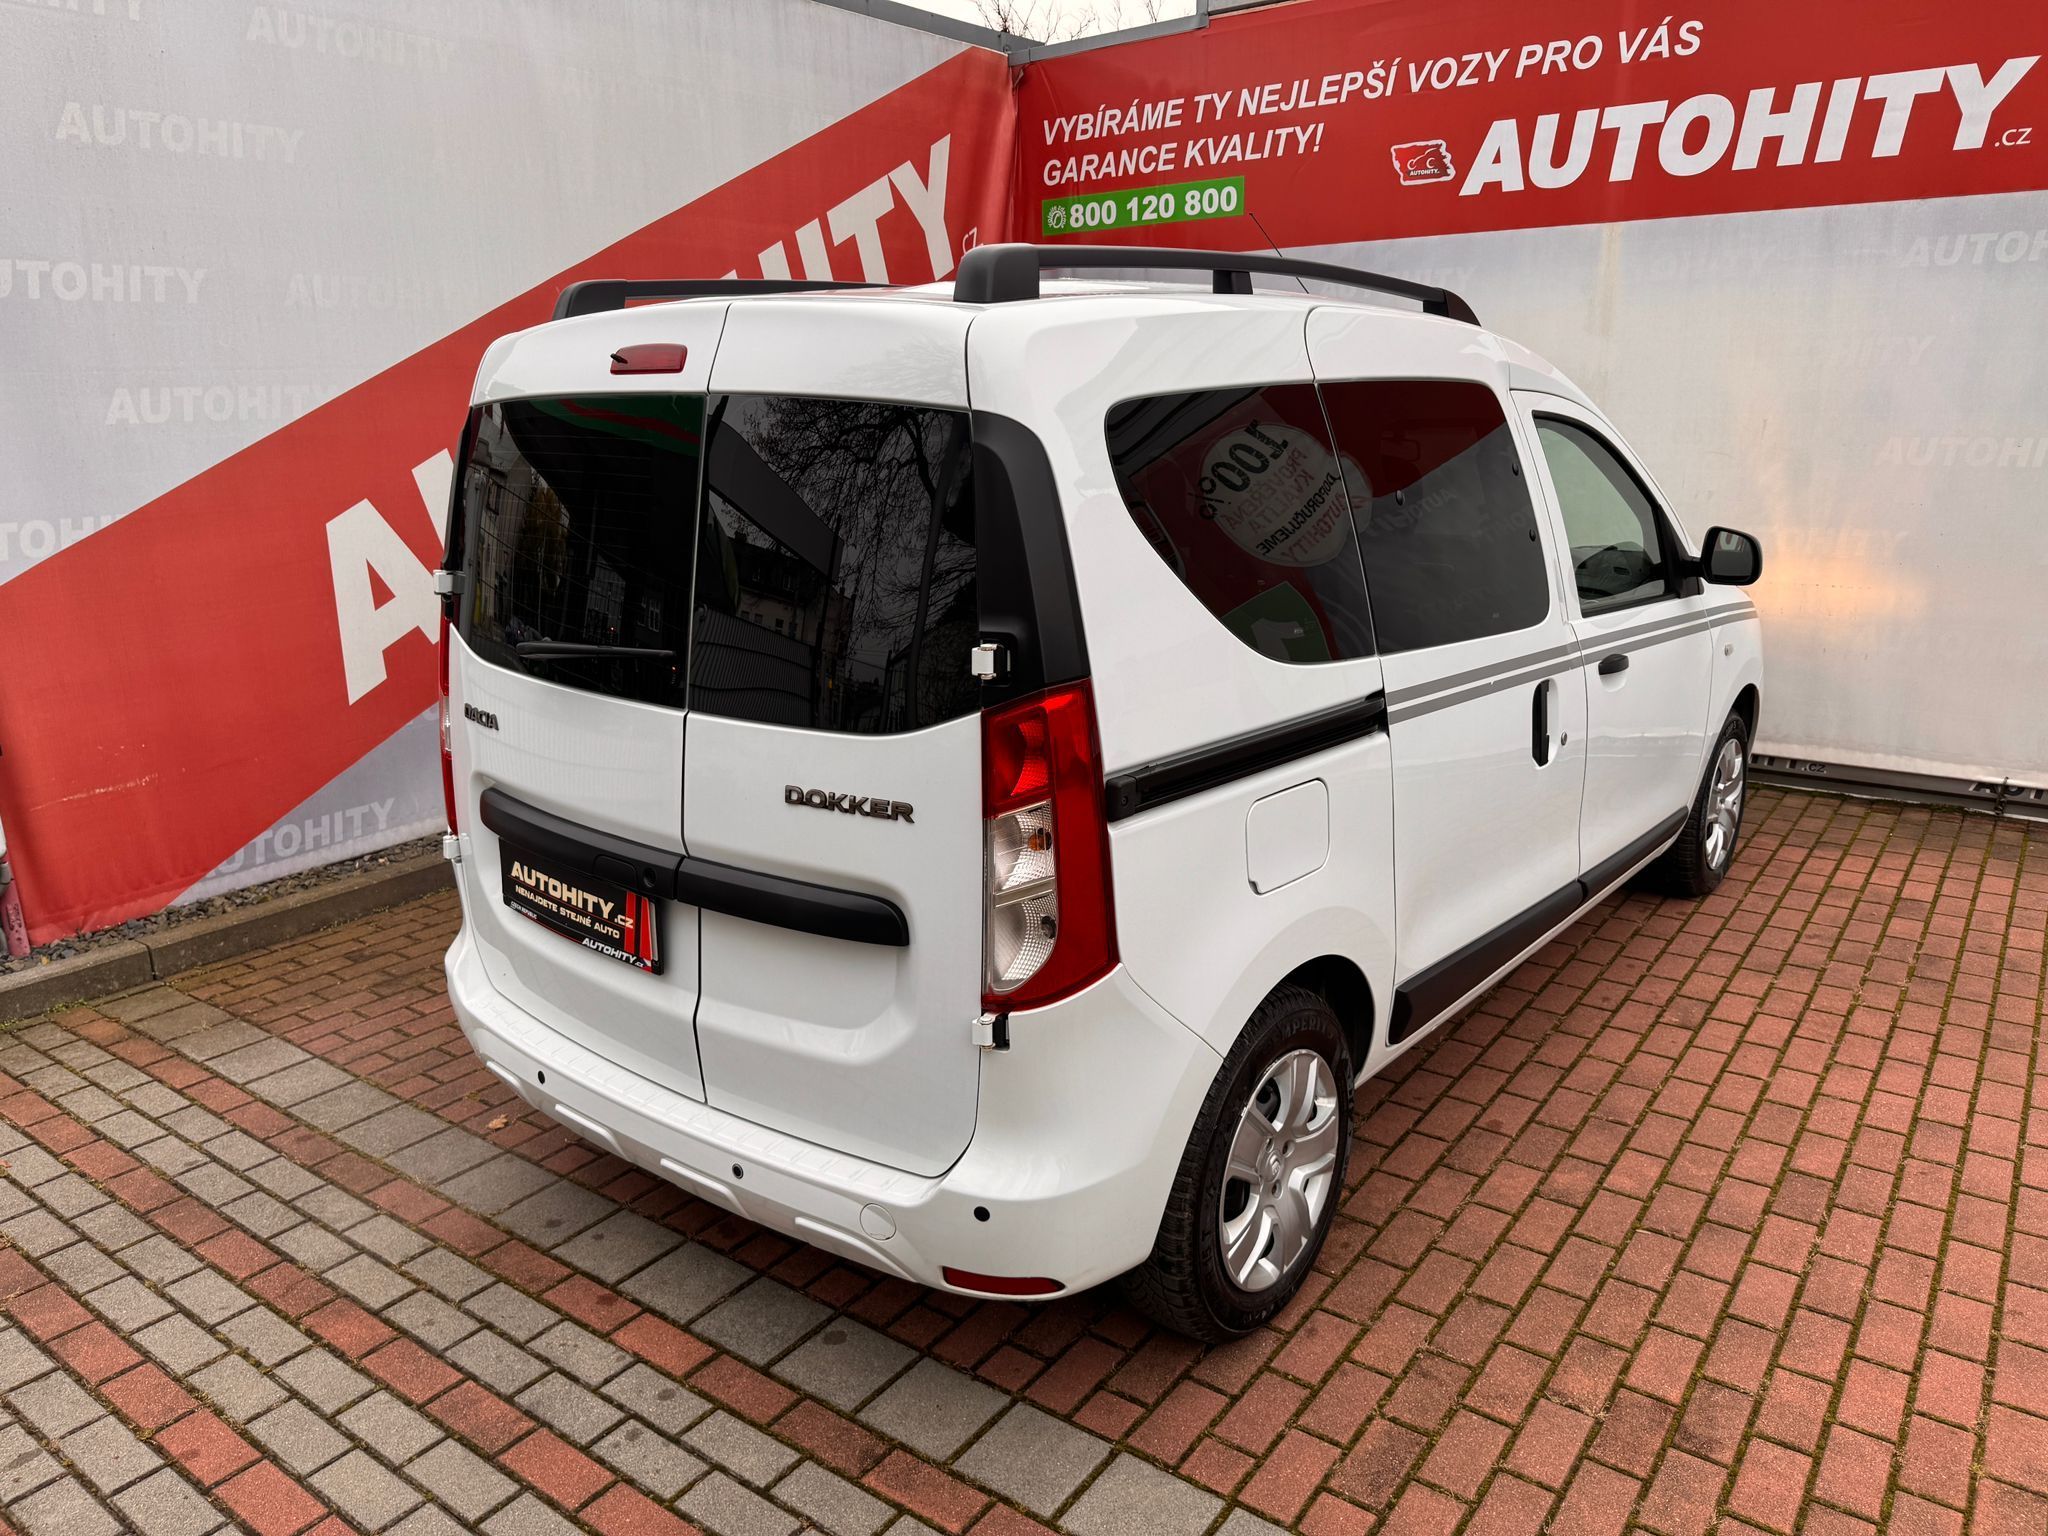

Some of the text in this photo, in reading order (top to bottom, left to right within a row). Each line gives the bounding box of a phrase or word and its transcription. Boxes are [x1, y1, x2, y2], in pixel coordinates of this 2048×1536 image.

[244, 6, 456, 73] AUTOHITY
[1042, 15, 1704, 146] VYBÍRÁME TY NEJLEPŠÍ VOZY PRO VÁS
[55, 101, 304, 165] AUTOHITY
[1042, 123, 1326, 187] GARANCE KVALITY!
[1069, 200, 1117, 229] 800
[1126, 193, 1175, 223] 120
[1184, 185, 1238, 218] 800
[464, 702, 499, 731] DACIA
[784, 784, 915, 824] DOKKER
[515, 884, 620, 939] NENAJDETE STEJNÉ AUTO
